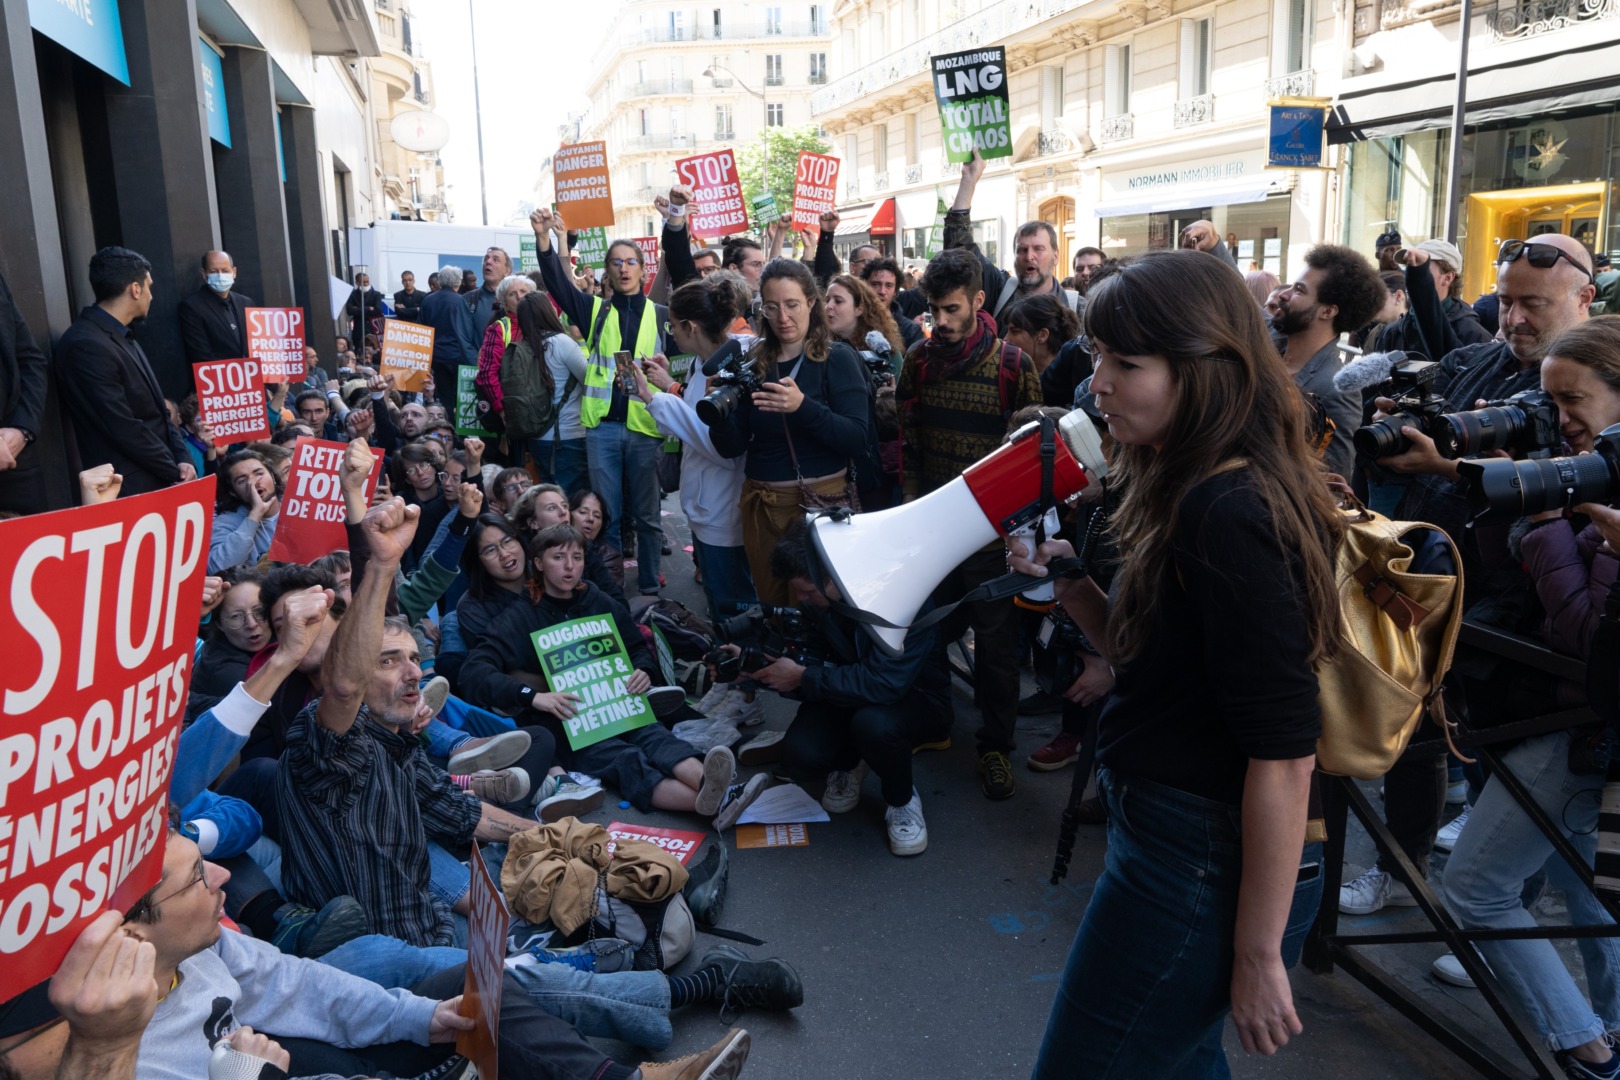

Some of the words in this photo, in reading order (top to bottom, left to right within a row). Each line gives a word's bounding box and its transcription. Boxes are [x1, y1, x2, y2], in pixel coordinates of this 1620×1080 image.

[936, 51, 1001, 70] MOZAMBIQUE
[937, 65, 1003, 98] LNG
[942, 99, 1006, 129] TOTAL
[949, 126, 1008, 153] CHAOS
[555, 153, 605, 173] DANGER
[680, 154, 733, 187] STOP
[799, 154, 838, 186] STOP
[1128, 171, 1178, 189] NORMANN
[1180, 161, 1244, 183] IMMOBILIER
[557, 175, 606, 190] MACRON
[557, 186, 608, 202] COMPLICE
[796, 183, 834, 201] PROJETS
[692, 211, 745, 230] FOSSILES
[794, 210, 820, 225] FOSSIL
[249, 310, 301, 337] STOP
[251, 338, 303, 350] PROJETS
[386, 330, 431, 347] DANGER
[384, 356, 429, 371] COMPLICE
[385, 347, 430, 362] MACRON
[198, 361, 258, 395] STOP
[261, 363, 304, 375] OSSILES
[203, 390, 262, 410] PROJETS
[205, 405, 264, 424] ÉNERGIES
[212, 418, 266, 437] OSSILES
[295, 469, 369, 504] TOTL
[286, 498, 311, 519] DE
[3, 501, 205, 716] STOP
[538, 619, 612, 650] OUGANDA
[549, 638, 614, 670] EACOP
[551, 660, 613, 692] DROITS
[614, 657, 629, 673] &
[567, 696, 646, 737] PIÉTINÉS
[0, 653, 188, 808] PROJETS
[0, 791, 167, 953] OSSILES
[471, 853, 503, 968] TOTAL
[470, 910, 499, 1011] CLIMATE
